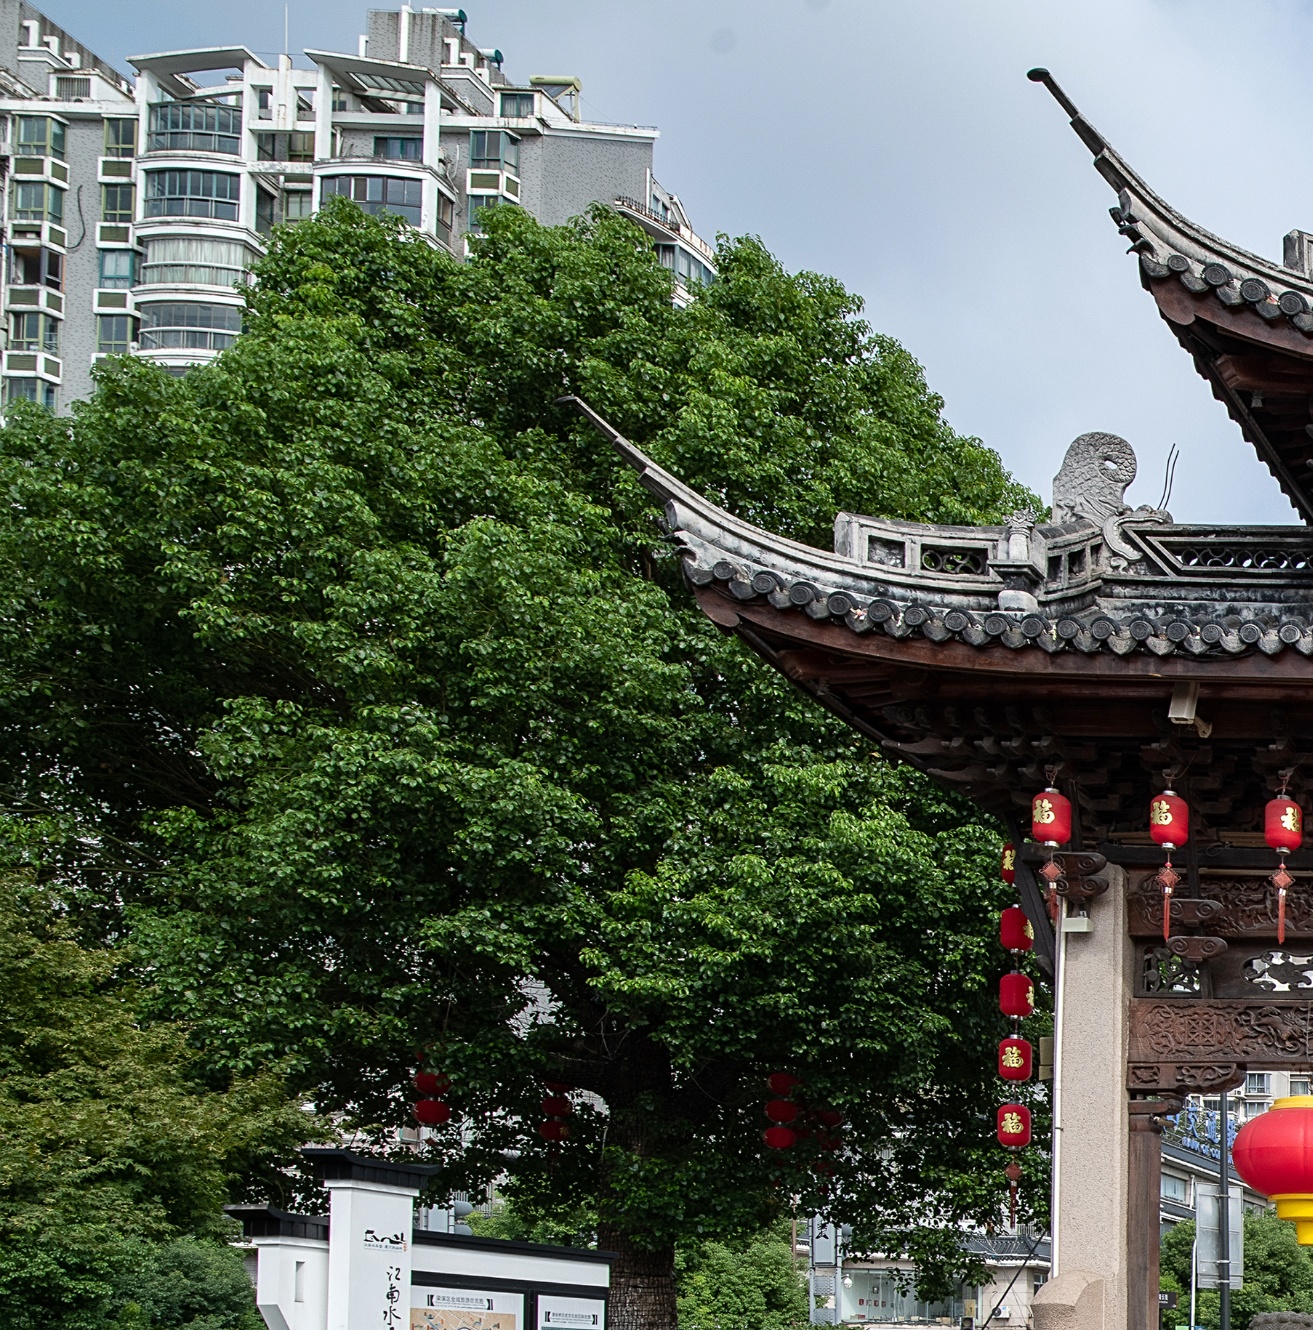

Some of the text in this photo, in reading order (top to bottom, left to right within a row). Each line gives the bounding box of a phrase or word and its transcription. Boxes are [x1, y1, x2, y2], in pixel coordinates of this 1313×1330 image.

[1033, 799, 1056, 824] 福
[1151, 800, 1173, 826] 福
[1002, 1046, 1024, 1068] 福
[1001, 1112, 1024, 1134] 福
